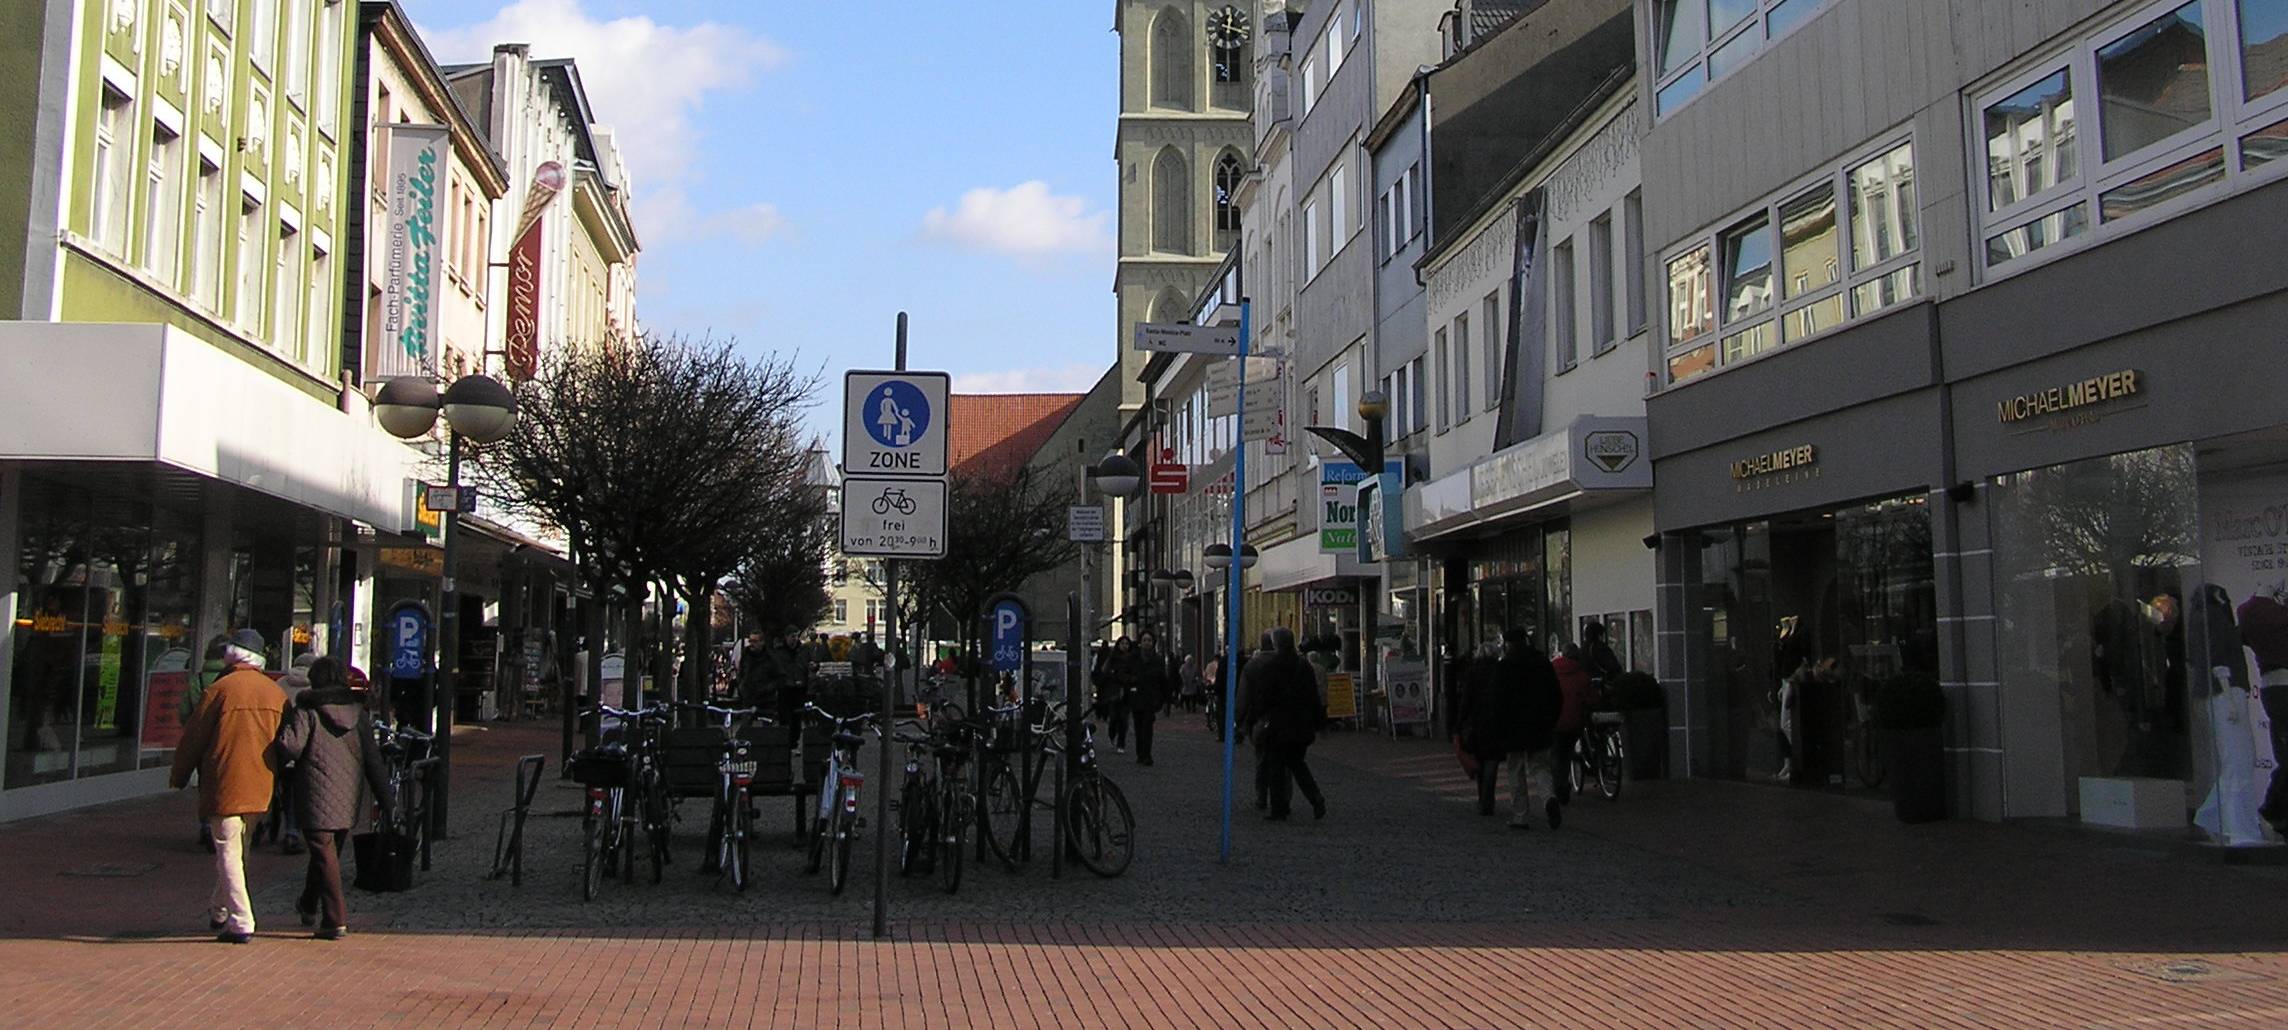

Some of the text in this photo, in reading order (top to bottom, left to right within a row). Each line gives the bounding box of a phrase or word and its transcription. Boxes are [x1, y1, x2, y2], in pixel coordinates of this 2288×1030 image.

[405, 146, 437, 246] Feiler
[385, 223, 404, 332] Fach-Parfümerie
[870, 452, 921, 469] ZONE
[882, 519, 906, 532] frei
[850, 537, 873, 546] von
[929, 537, 938, 548] h
[399, 616, 420, 649] P
[997, 609, 1017, 640] P
